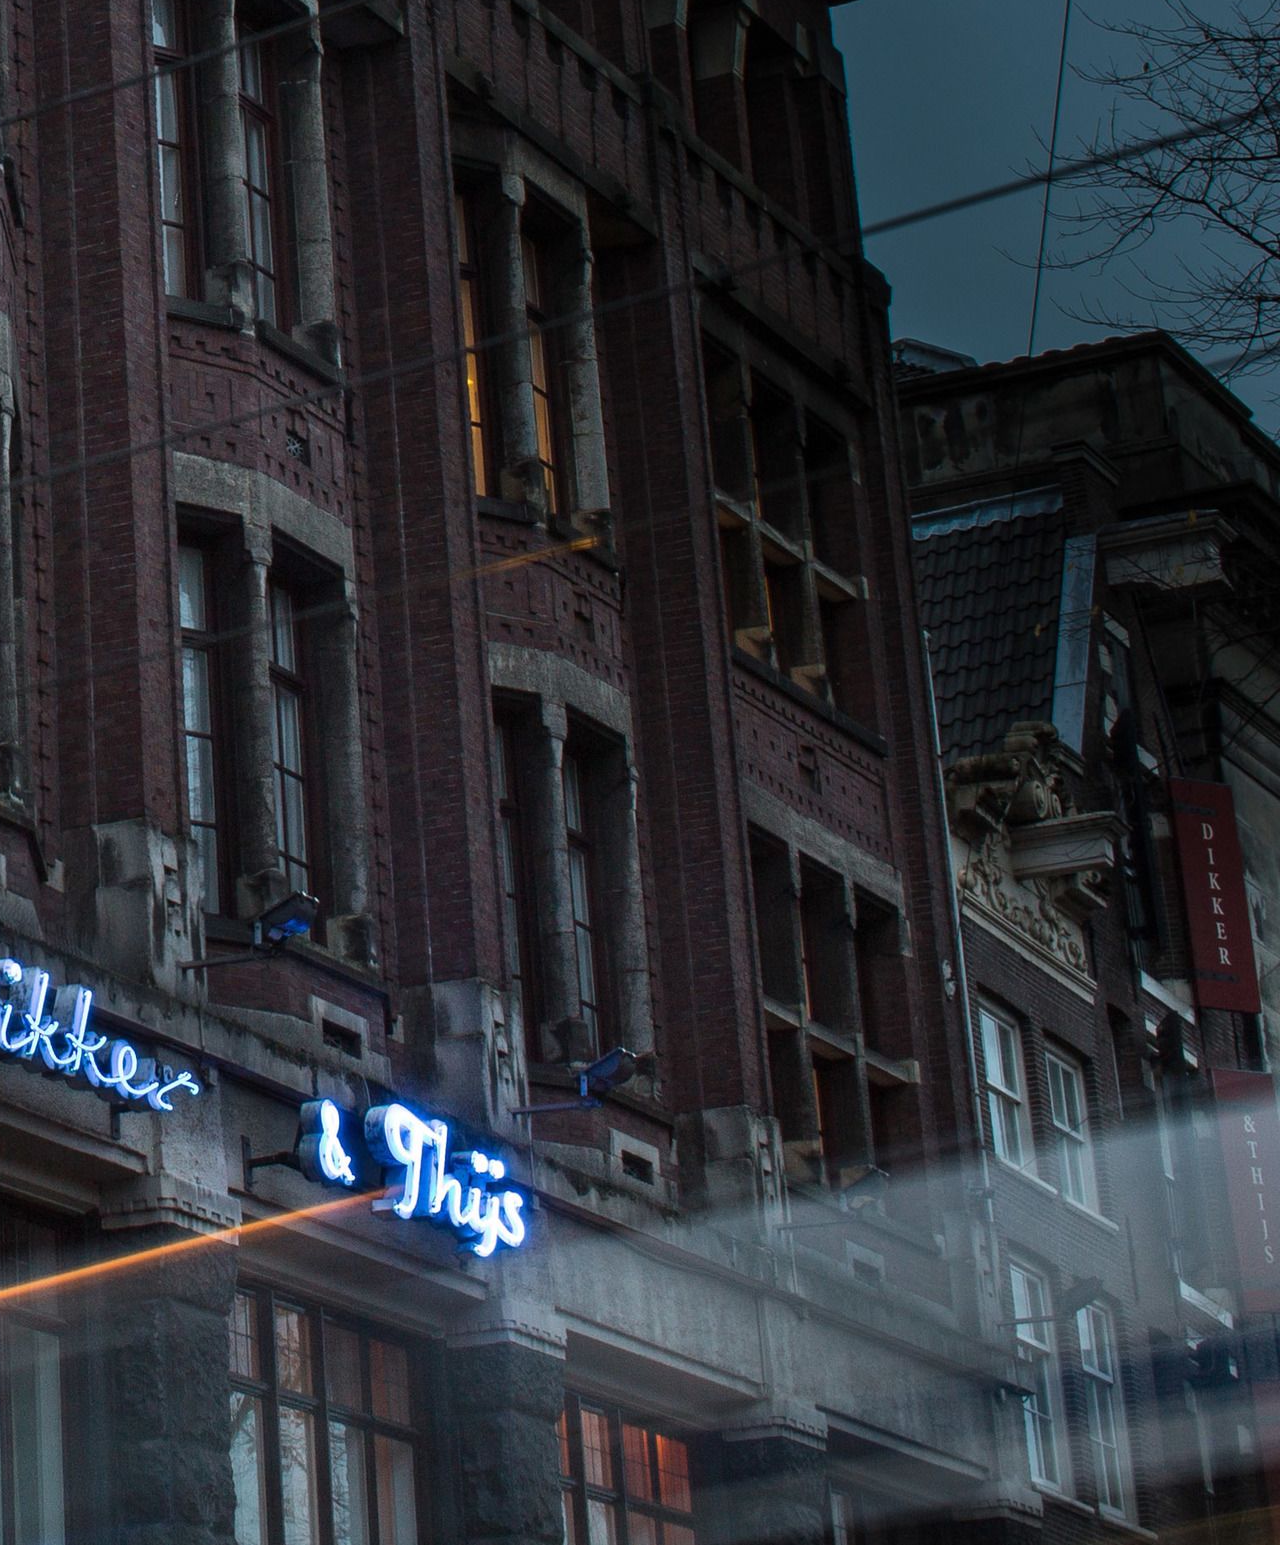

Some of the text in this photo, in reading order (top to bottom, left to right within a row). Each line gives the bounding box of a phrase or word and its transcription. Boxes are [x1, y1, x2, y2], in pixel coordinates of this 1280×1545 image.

[1200, 821, 1233, 967] DIKKER
[308, 1098, 357, 1186] &
[1243, 1114, 1275, 1264] & THIJS
